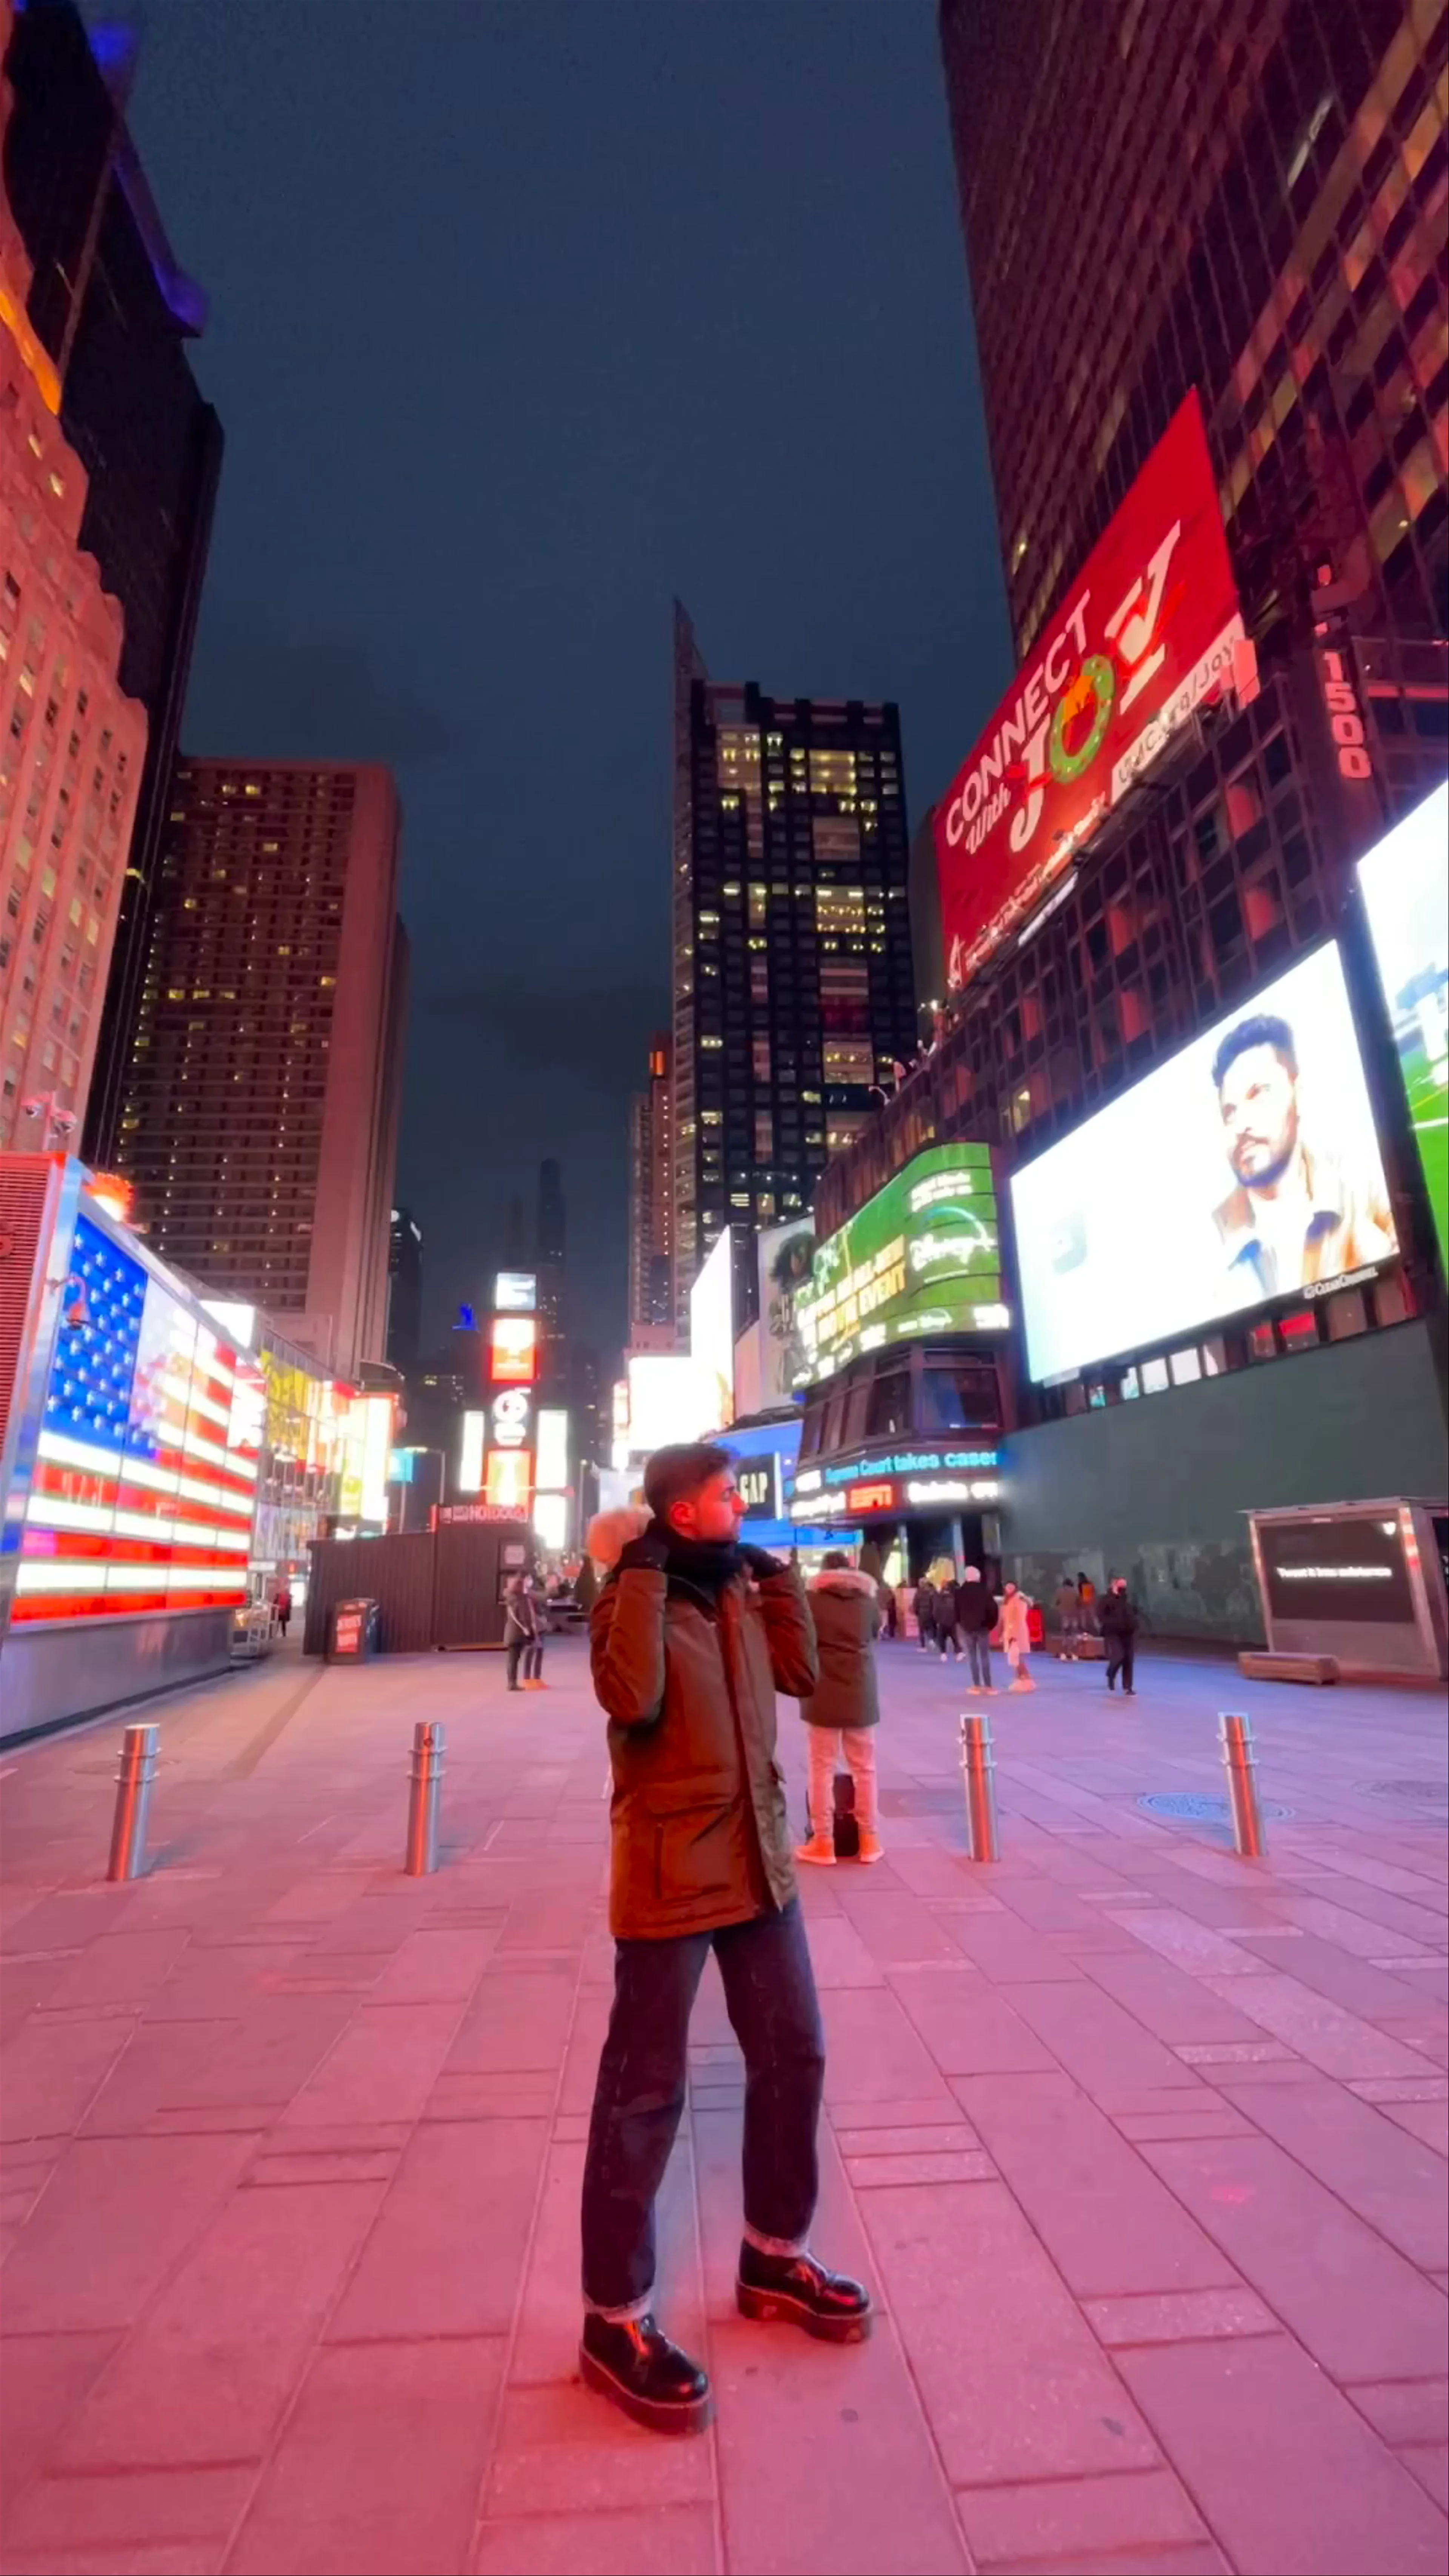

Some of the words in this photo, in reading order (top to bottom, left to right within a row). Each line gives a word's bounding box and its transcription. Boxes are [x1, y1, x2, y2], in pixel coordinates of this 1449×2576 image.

[946, 589, 1091, 846] CONNECT
[1323, 651, 1371, 779] 1500
[965, 782, 1011, 855] With
[740, 1472, 768, 1504] GAP
[894, 1453, 939, 1472] takes
